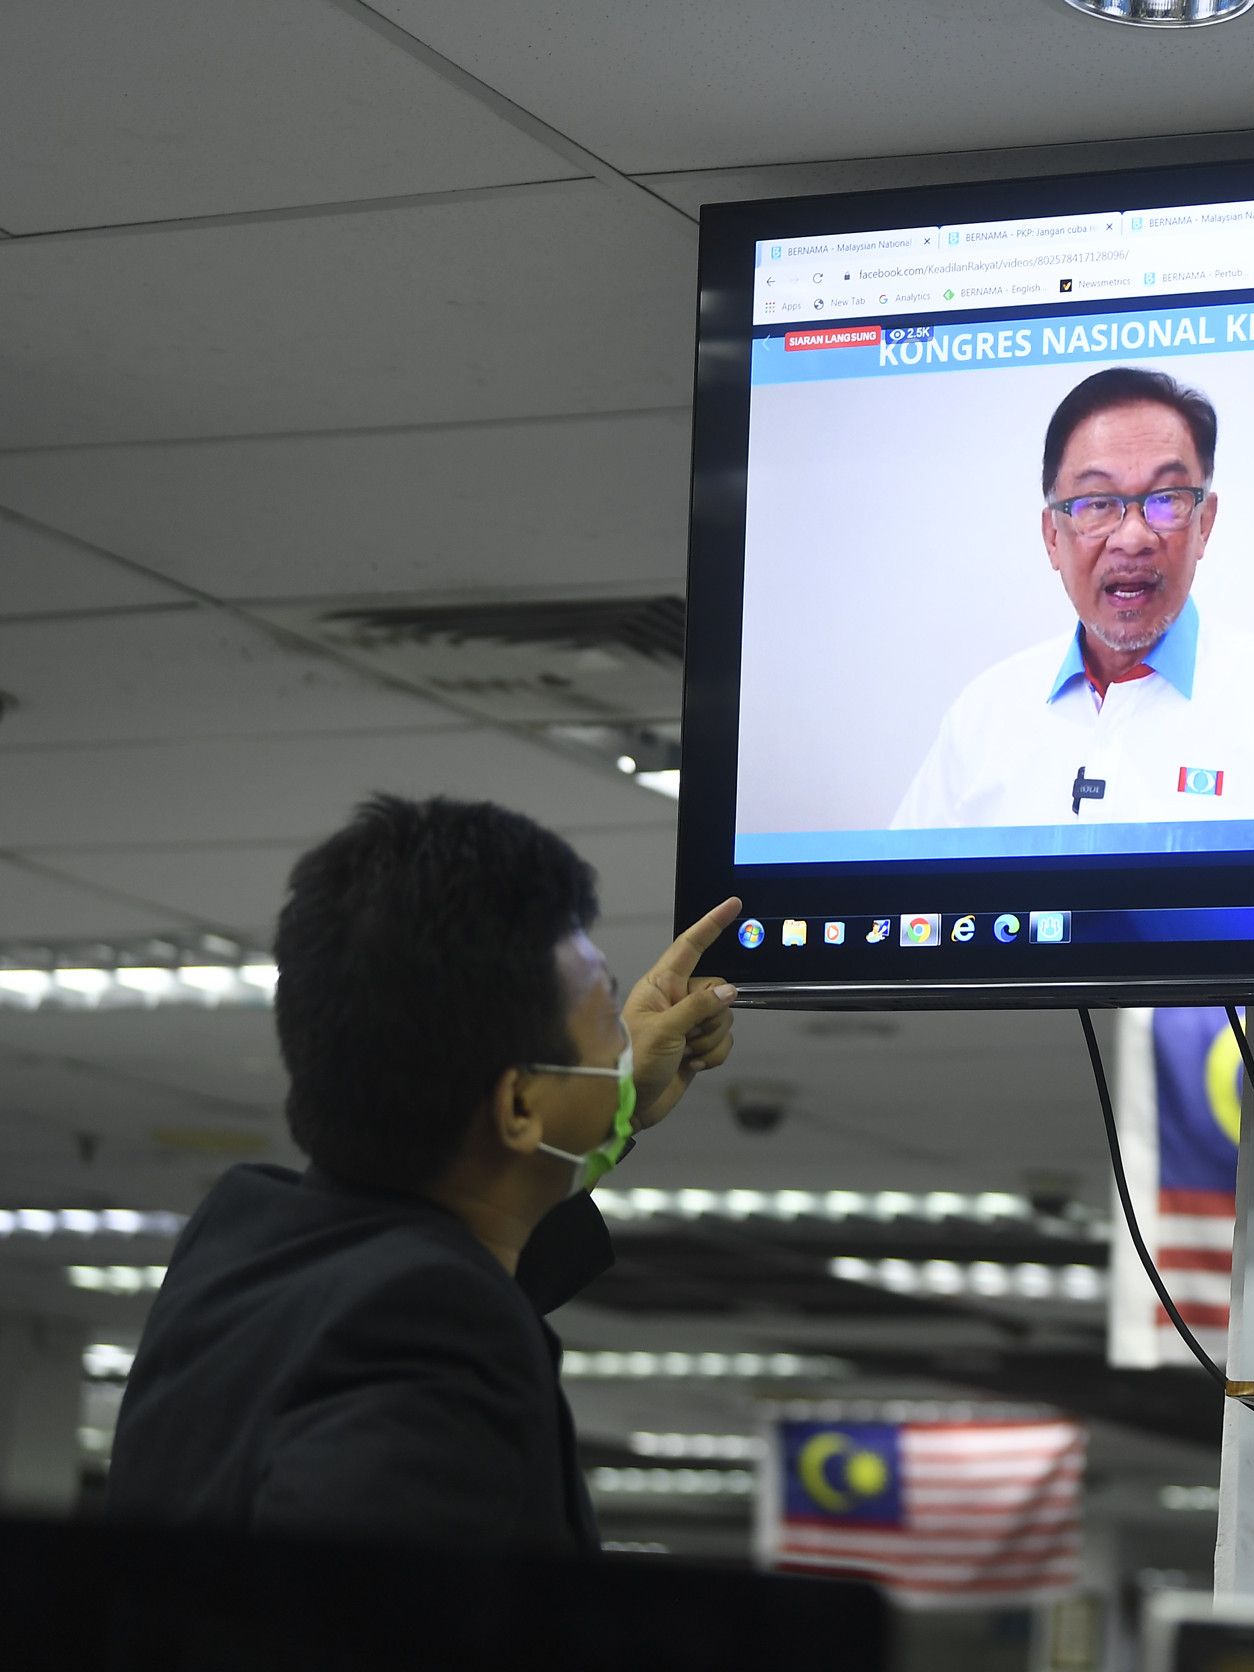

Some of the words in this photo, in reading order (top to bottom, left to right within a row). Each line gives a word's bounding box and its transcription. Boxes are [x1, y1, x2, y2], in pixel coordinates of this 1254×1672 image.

[1149, 216, 1192, 227] BERNAMA
[1202, 212, 1242, 224] Malaysian
[965, 231, 1008, 242] BERNAMA
[1036, 226, 1064, 238] Jangan
[1067, 224, 1087, 234] cuba
[788, 245, 828, 256] BERNAMA
[837, 242, 876, 253] Malaysian
[1162, 271, 1206, 282] BERNAMA
[895, 293, 931, 303] Analytics
[961, 286, 1003, 297] BERNAMA
[782, 302, 801, 311] Apps
[831, 299, 848, 307] New
[851, 296, 865, 305] Tab
[789, 334, 824, 347] SIARAN
[825, 331, 877, 344] LANGSUNG
[907, 326, 930, 339] 2.5K
[879, 330, 1032, 367] KONGRES
[1042, 316, 1215, 356] NASIONAL
